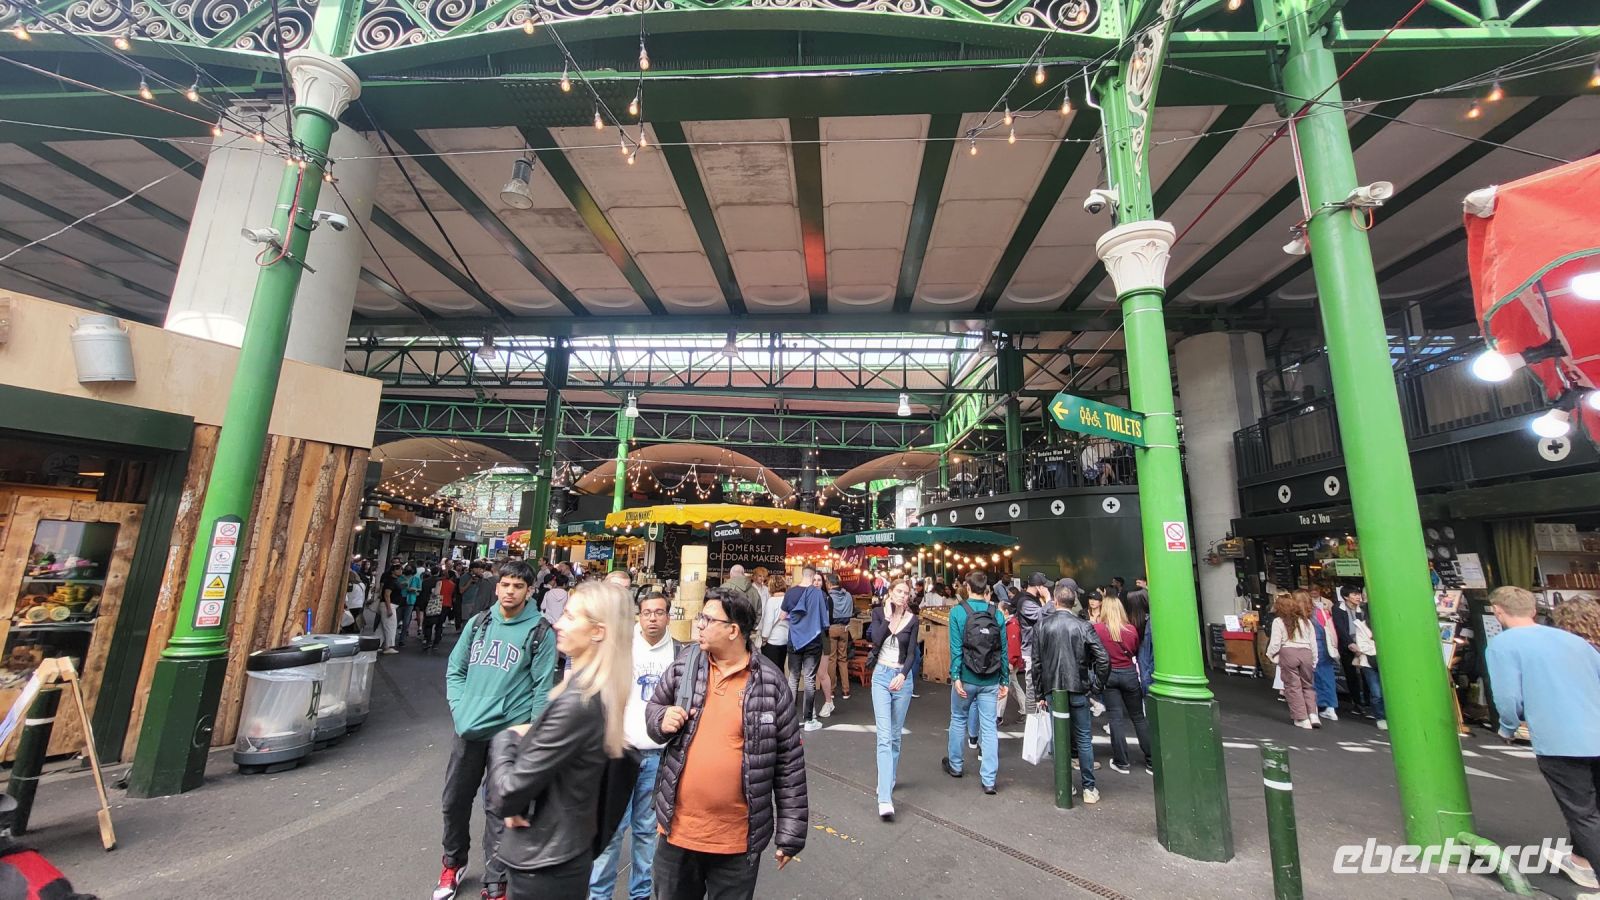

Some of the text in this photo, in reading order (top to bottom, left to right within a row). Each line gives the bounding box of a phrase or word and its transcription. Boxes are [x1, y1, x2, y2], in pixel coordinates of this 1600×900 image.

[1104, 411, 1142, 438] TOILETS
[1299, 513, 1330, 525] Tea 2 You
[714, 528, 741, 537] CHEDDAR
[722, 543, 773, 553] SOMERSET
[709, 552, 785, 563] CHEDDAR MAKERS
[469, 639, 521, 672] GAP
